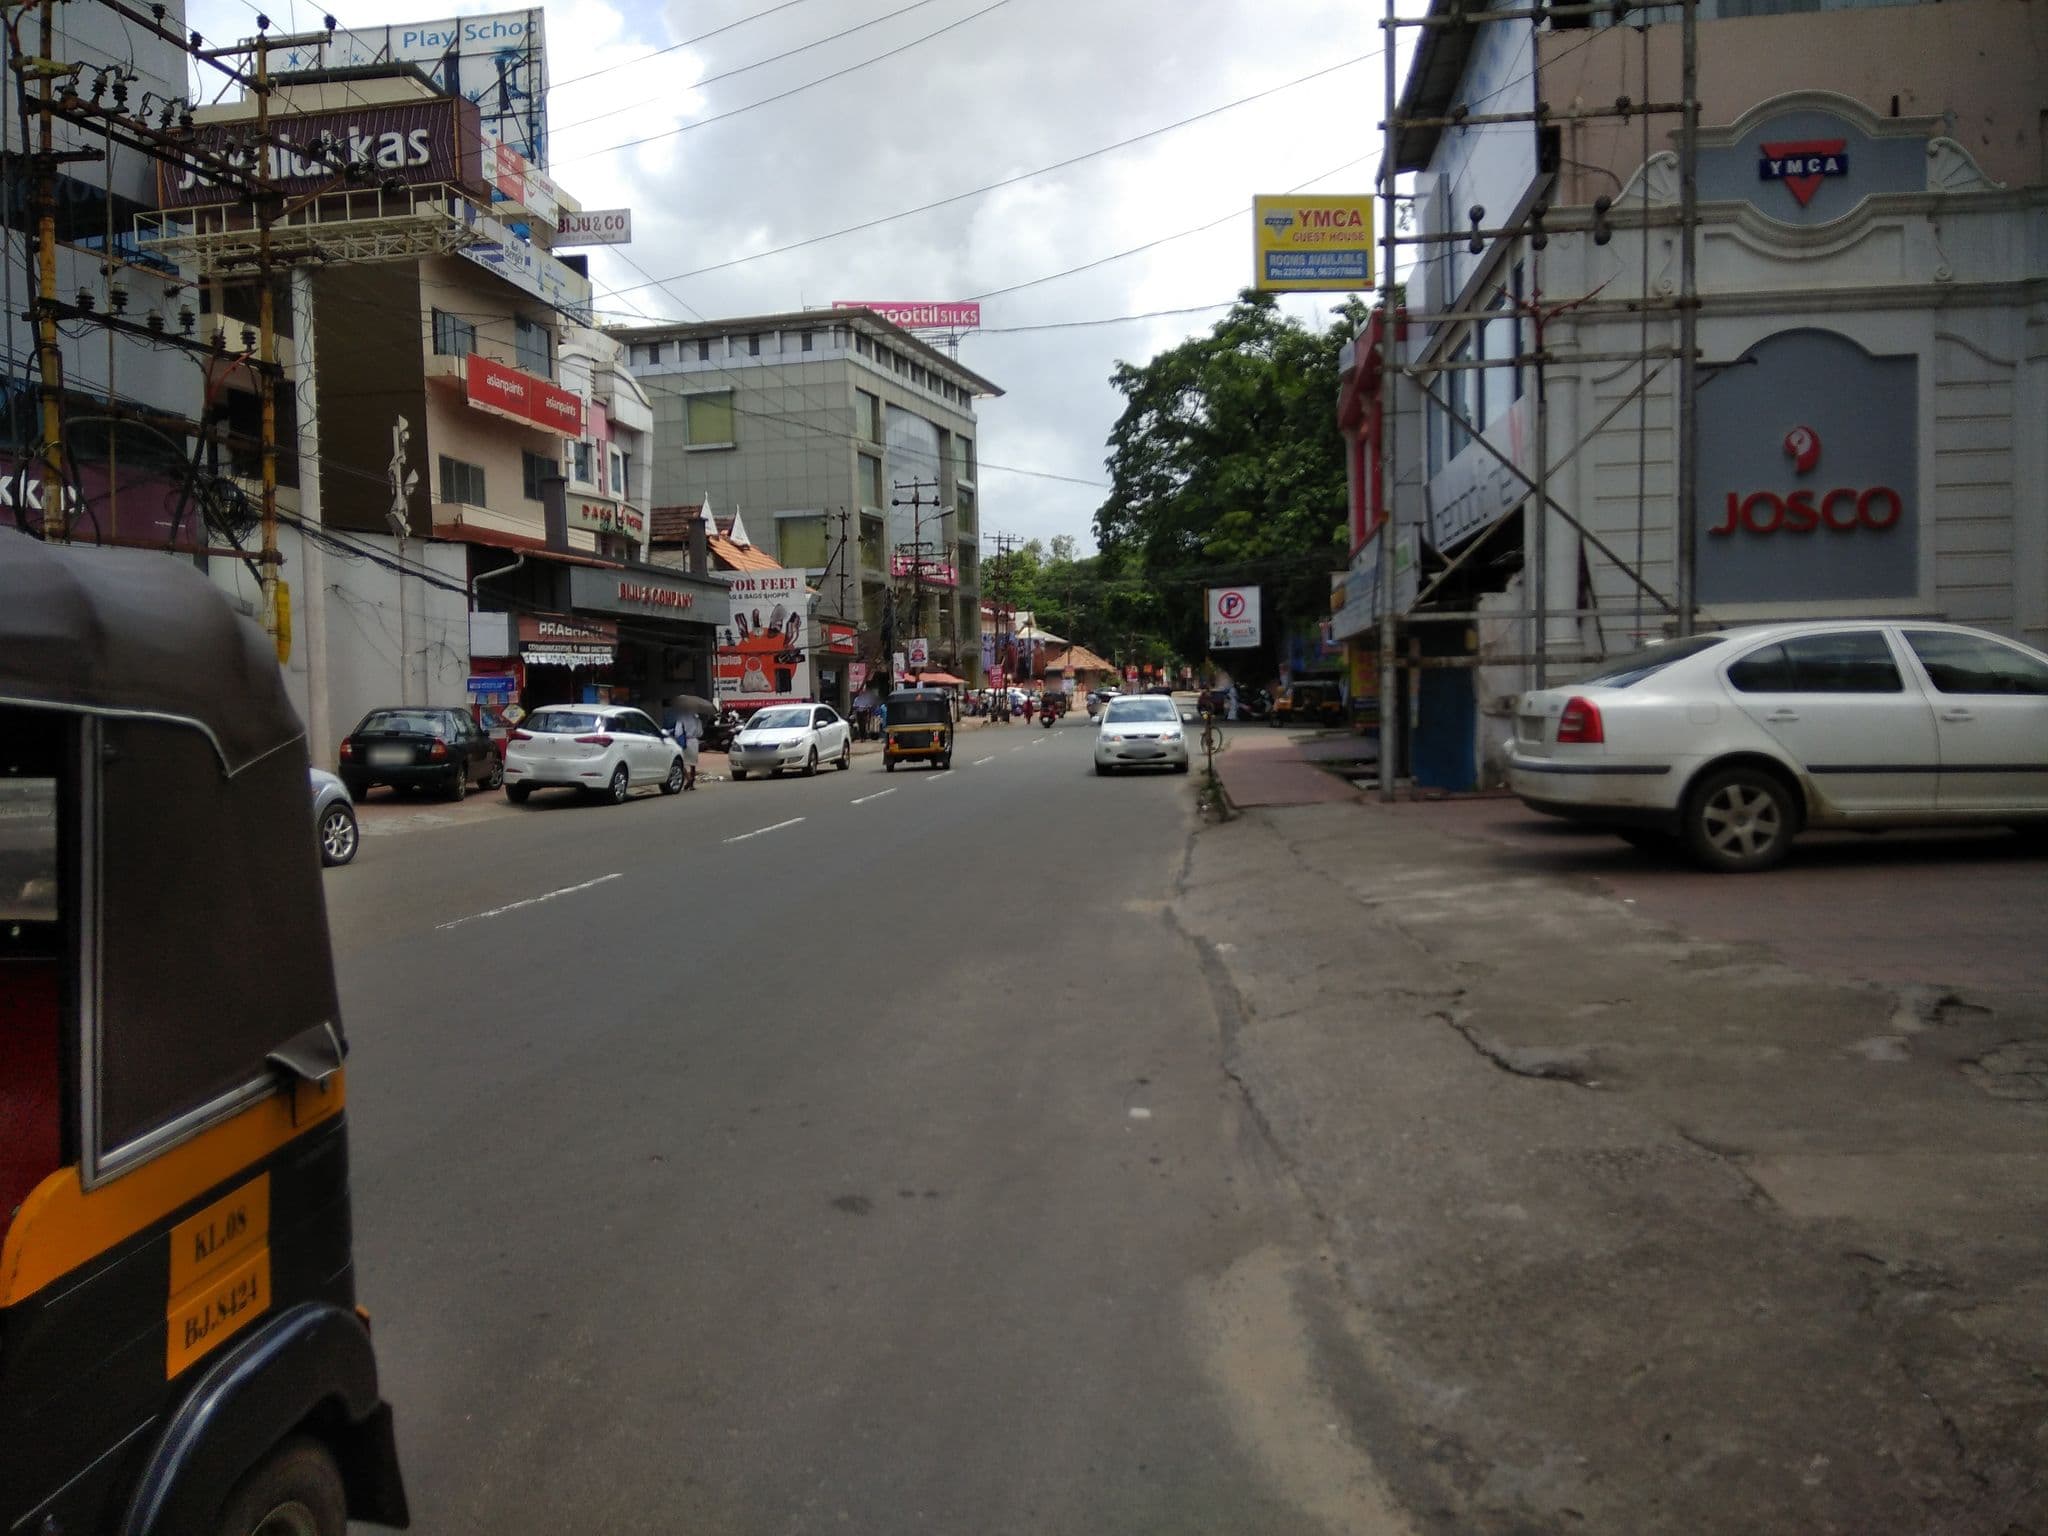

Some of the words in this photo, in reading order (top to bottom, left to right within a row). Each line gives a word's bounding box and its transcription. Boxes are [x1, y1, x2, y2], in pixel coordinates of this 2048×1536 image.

[402, 30, 455, 49] Play
[1769, 157, 1840, 175] YMCA
[557, 216, 591, 234] BIJU
[1298, 207, 1364, 228] YMCA
[1292, 231, 1327, 243] GUEST
[1329, 231, 1366, 243] HOUSE
[1269, 253, 1306, 266] ROOMS
[1308, 252, 1364, 266] AVAILABLE
[940, 309, 978, 323] SILKS
[1708, 485, 1903, 537] JOSCO
[761, 576, 798, 591] FEET
[618, 582, 641, 601] BIJU
[650, 587, 694, 609] COMPANY
[744, 592, 763, 600] BAGS
